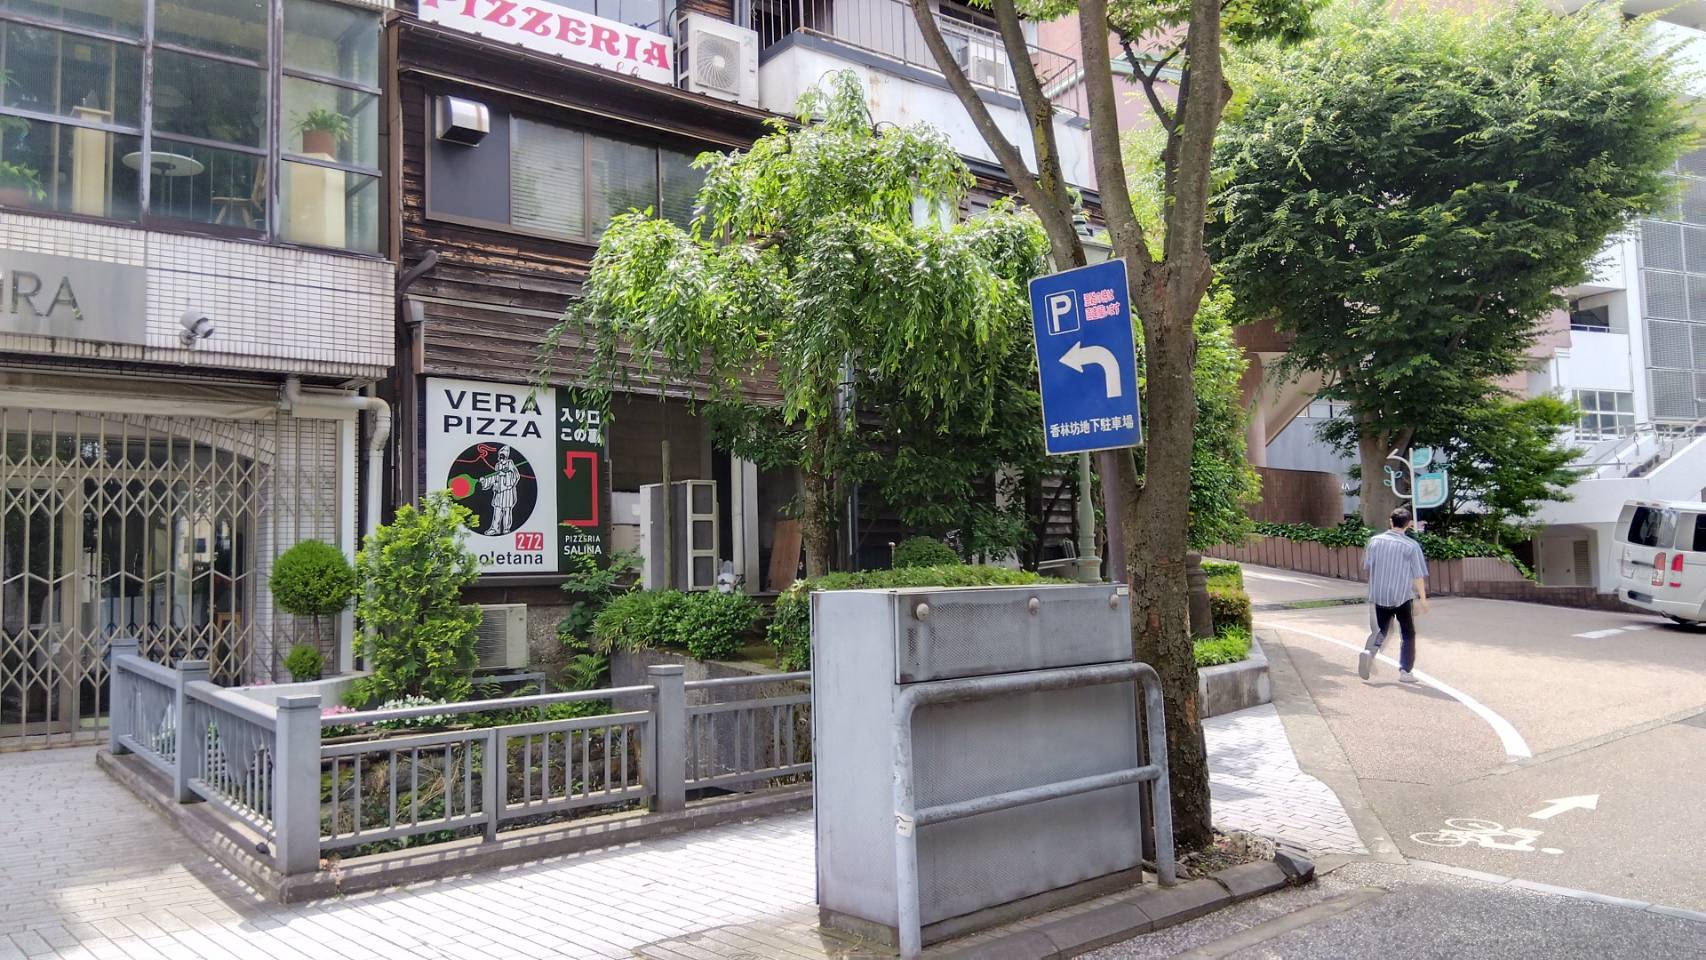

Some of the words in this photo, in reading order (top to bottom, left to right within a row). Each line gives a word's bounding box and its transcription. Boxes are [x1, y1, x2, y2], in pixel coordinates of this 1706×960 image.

[423, 0, 670, 70] IZZERIA
[0, 270, 83, 320] RA
[1050, 294, 1072, 332] P
[444, 389, 542, 416] VERA
[443, 415, 542, 439] PIZZA
[560, 407, 600, 424] 入り口
[1050, 415, 1134, 438] 香林坊地下駐車場
[516, 533, 543, 550] 272
[565, 534, 601, 543] PIZZERIA
[563, 545, 602, 556] SALINA
